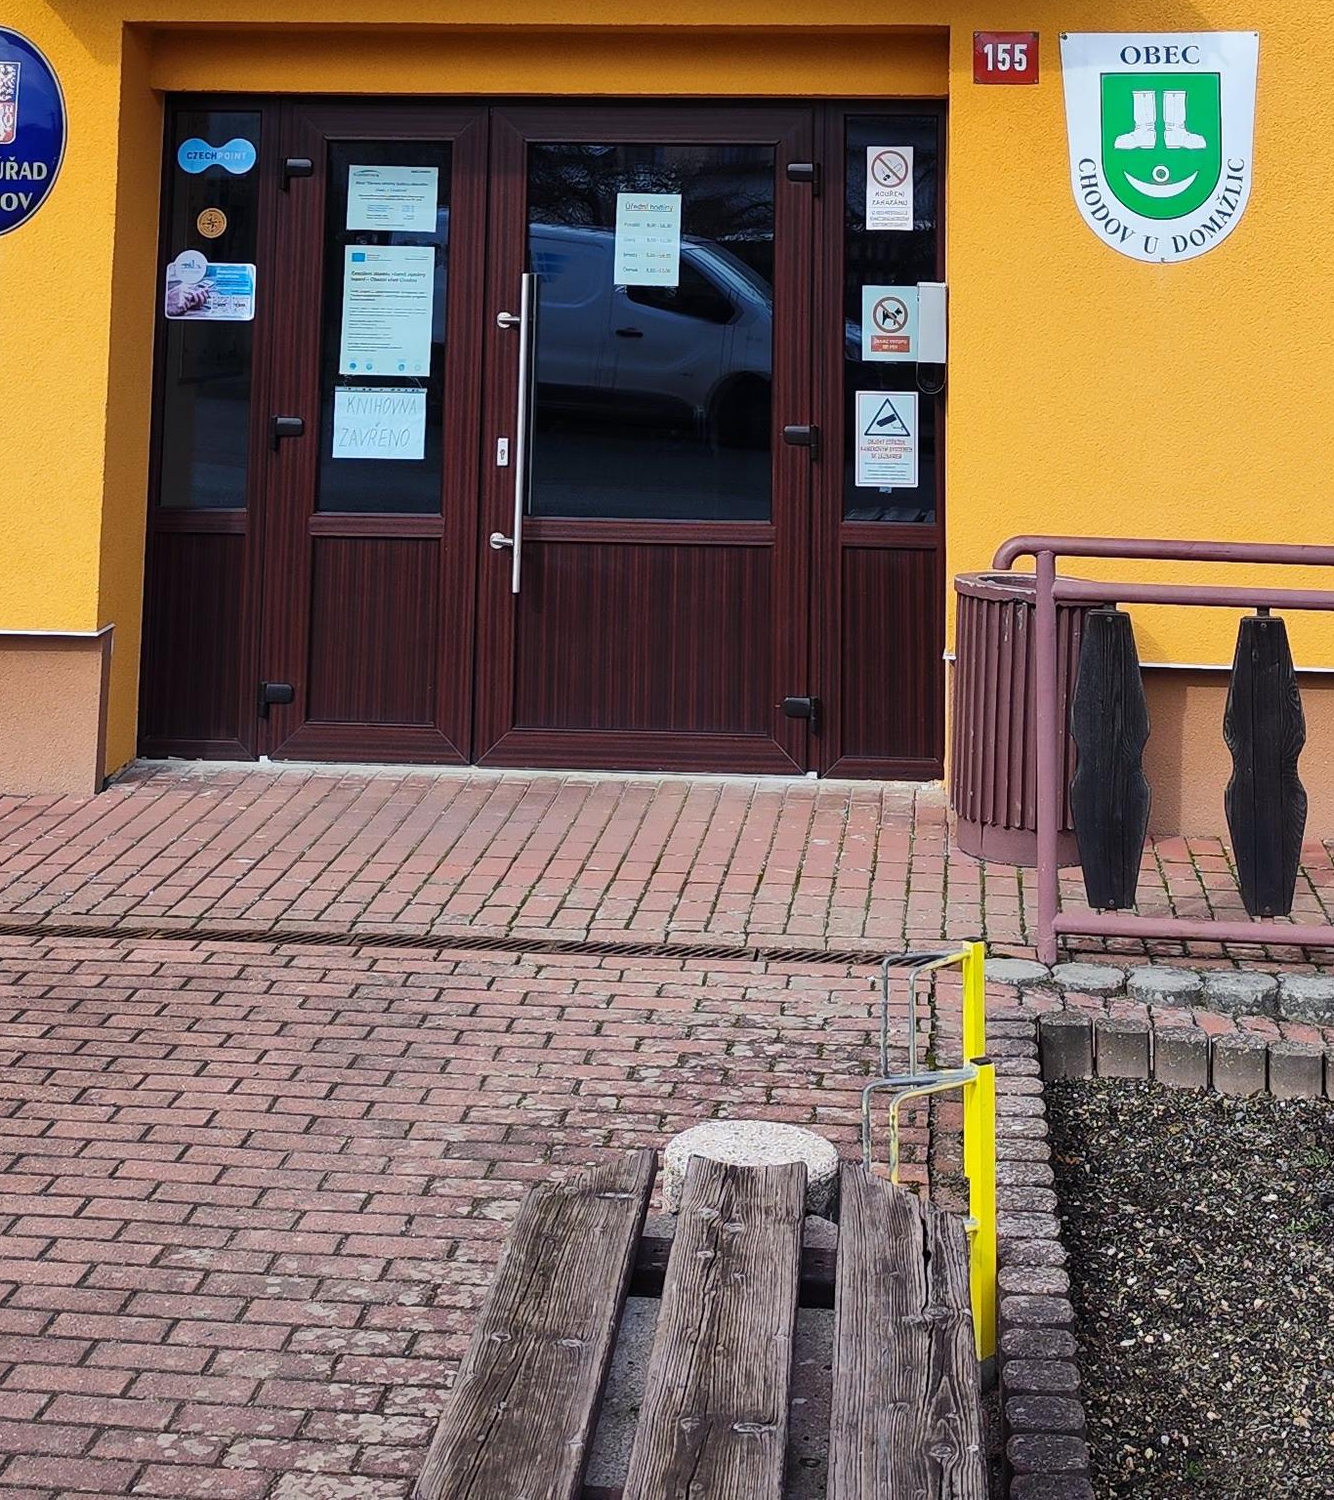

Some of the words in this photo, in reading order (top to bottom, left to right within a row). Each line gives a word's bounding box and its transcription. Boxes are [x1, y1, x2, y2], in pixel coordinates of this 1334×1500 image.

[983, 43, 1028, 71] 155
[1120, 45, 1200, 65] OBEC
[1078, 157, 1136, 244] CHODOV
[1143, 235, 1159, 254] U
[1171, 157, 1245, 253] DOMAŽLIC
[346, 395, 418, 415] KNIHOVNA
[338, 421, 411, 447] ZAVŘENO
